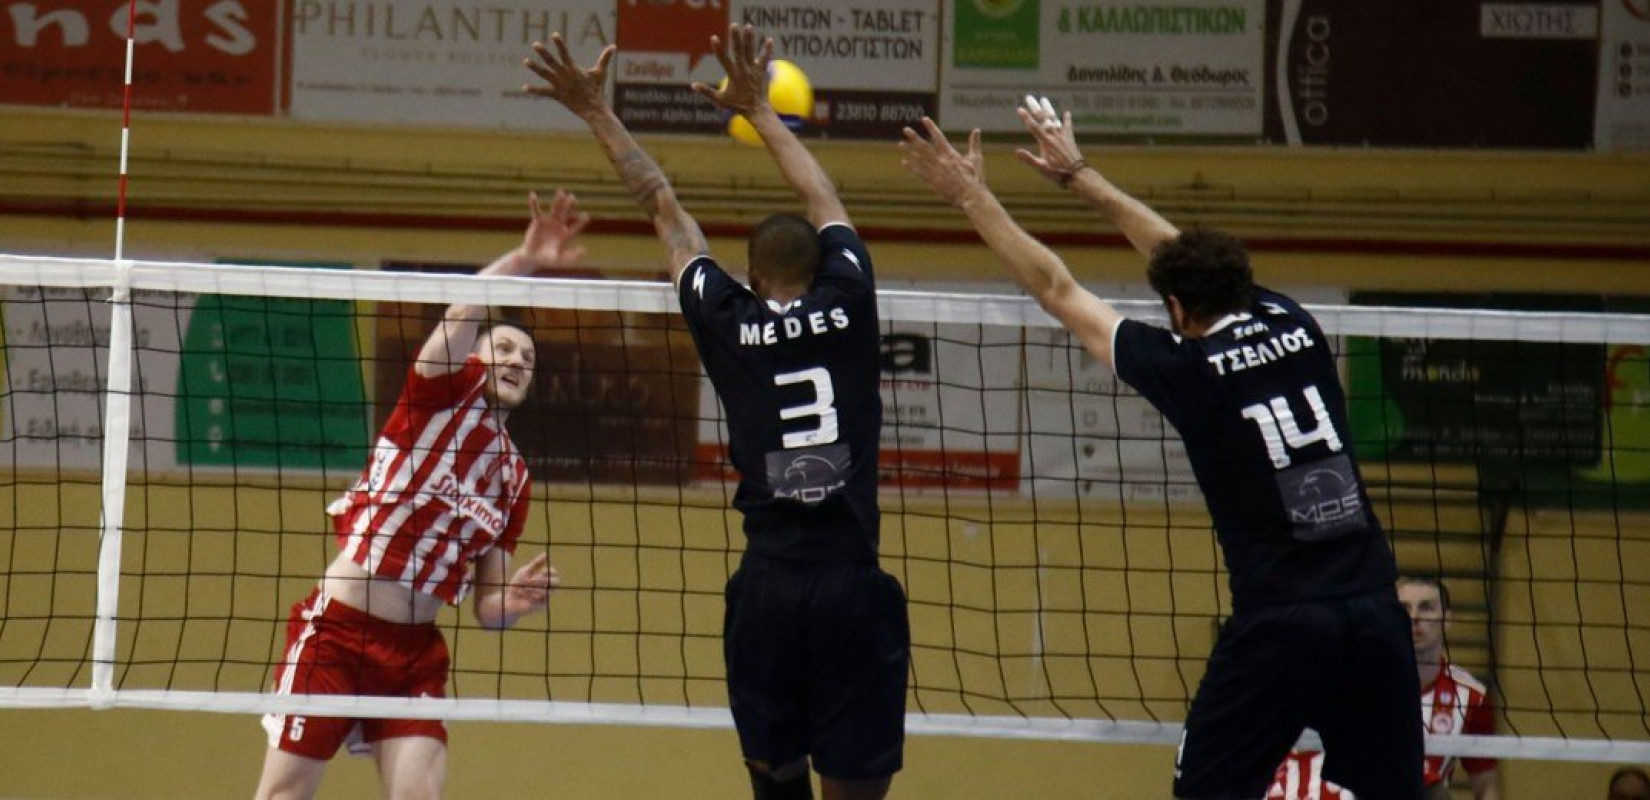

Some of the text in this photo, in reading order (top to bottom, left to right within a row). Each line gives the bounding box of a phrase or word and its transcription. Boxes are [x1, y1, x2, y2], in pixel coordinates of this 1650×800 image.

[297, 2, 606, 45] PHILANTHIA
[743, 7, 832, 30] ΚΙΝΗΤΩΝ
[851, 9, 924, 32] TABLET
[780, 36, 923, 59] ΥΠΟΛΟΓΙΣΤΩΝ
[739, 307, 850, 346] MEDES
[1207, 327, 1315, 376] ΤΣΕΛΙΟΣ
[773, 366, 839, 449] 3
[1241, 385, 1343, 469] 14
